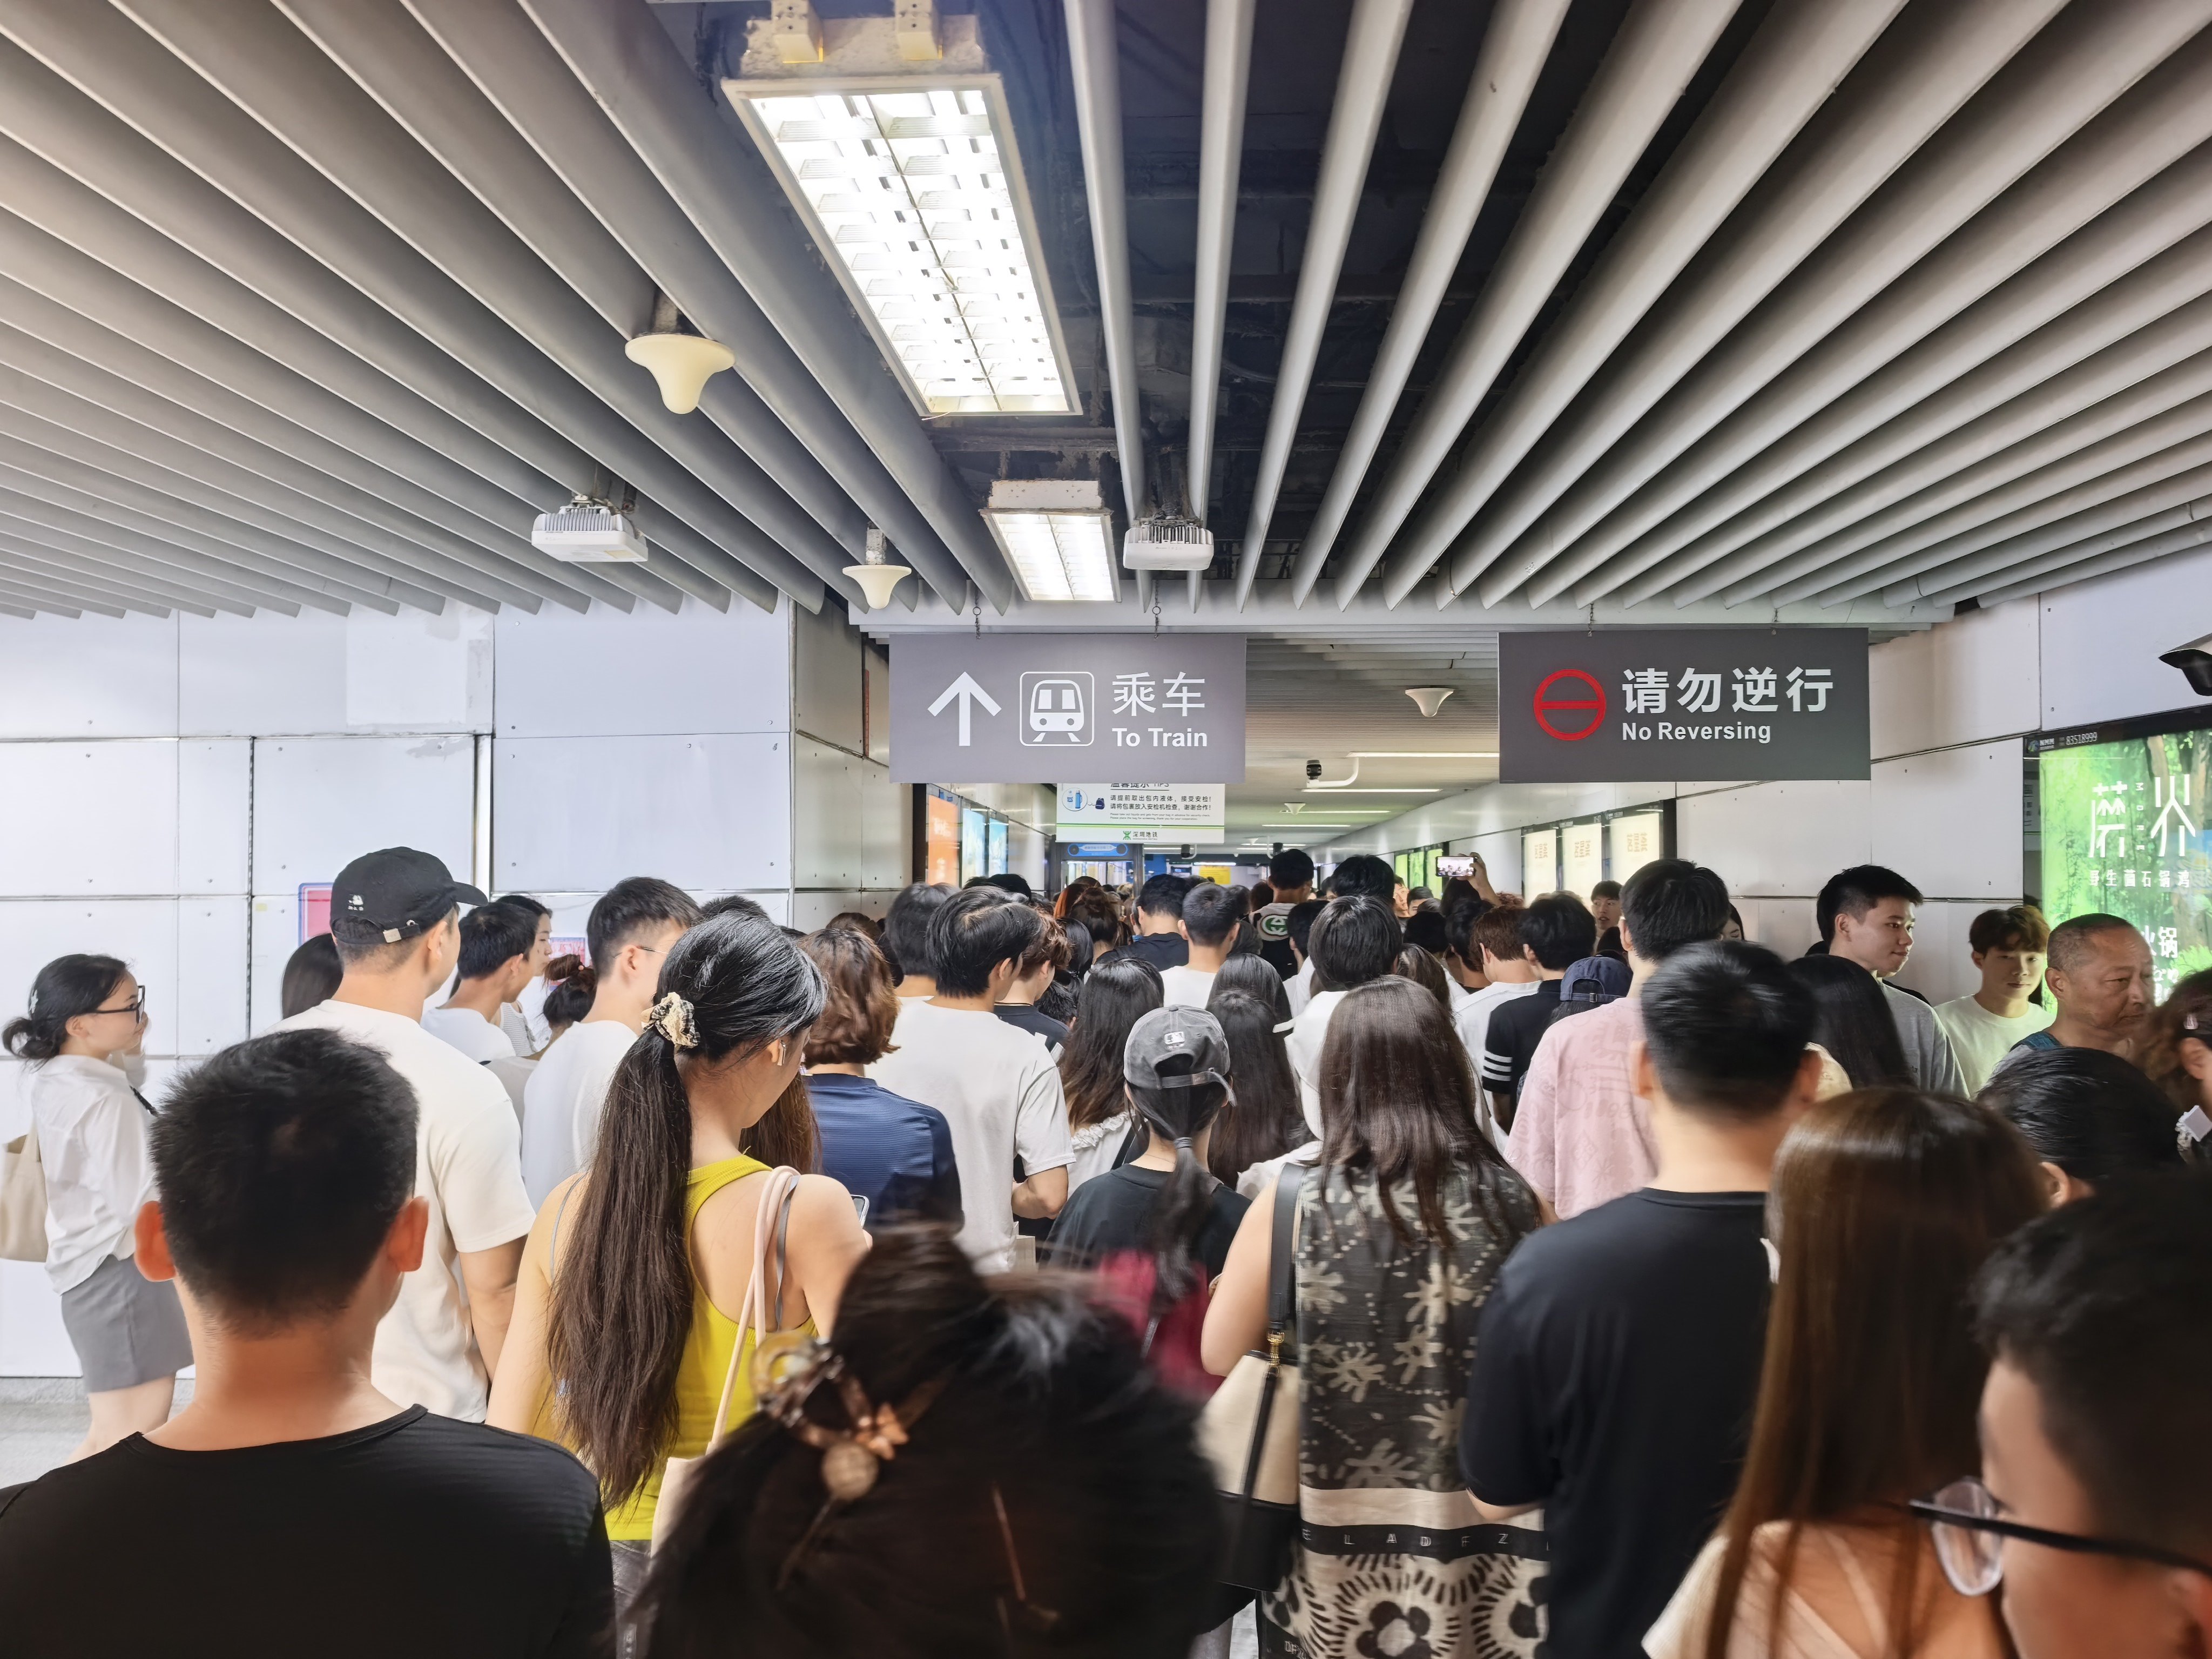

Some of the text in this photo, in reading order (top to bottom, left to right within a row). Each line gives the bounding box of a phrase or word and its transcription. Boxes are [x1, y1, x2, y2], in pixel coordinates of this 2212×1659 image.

[1112, 672, 1206, 717] 乘车
[1622, 666, 1833, 713] 请勿逆行
[1112, 727, 1208, 747] To Train
[1622, 722, 1771, 744] No Reversing
